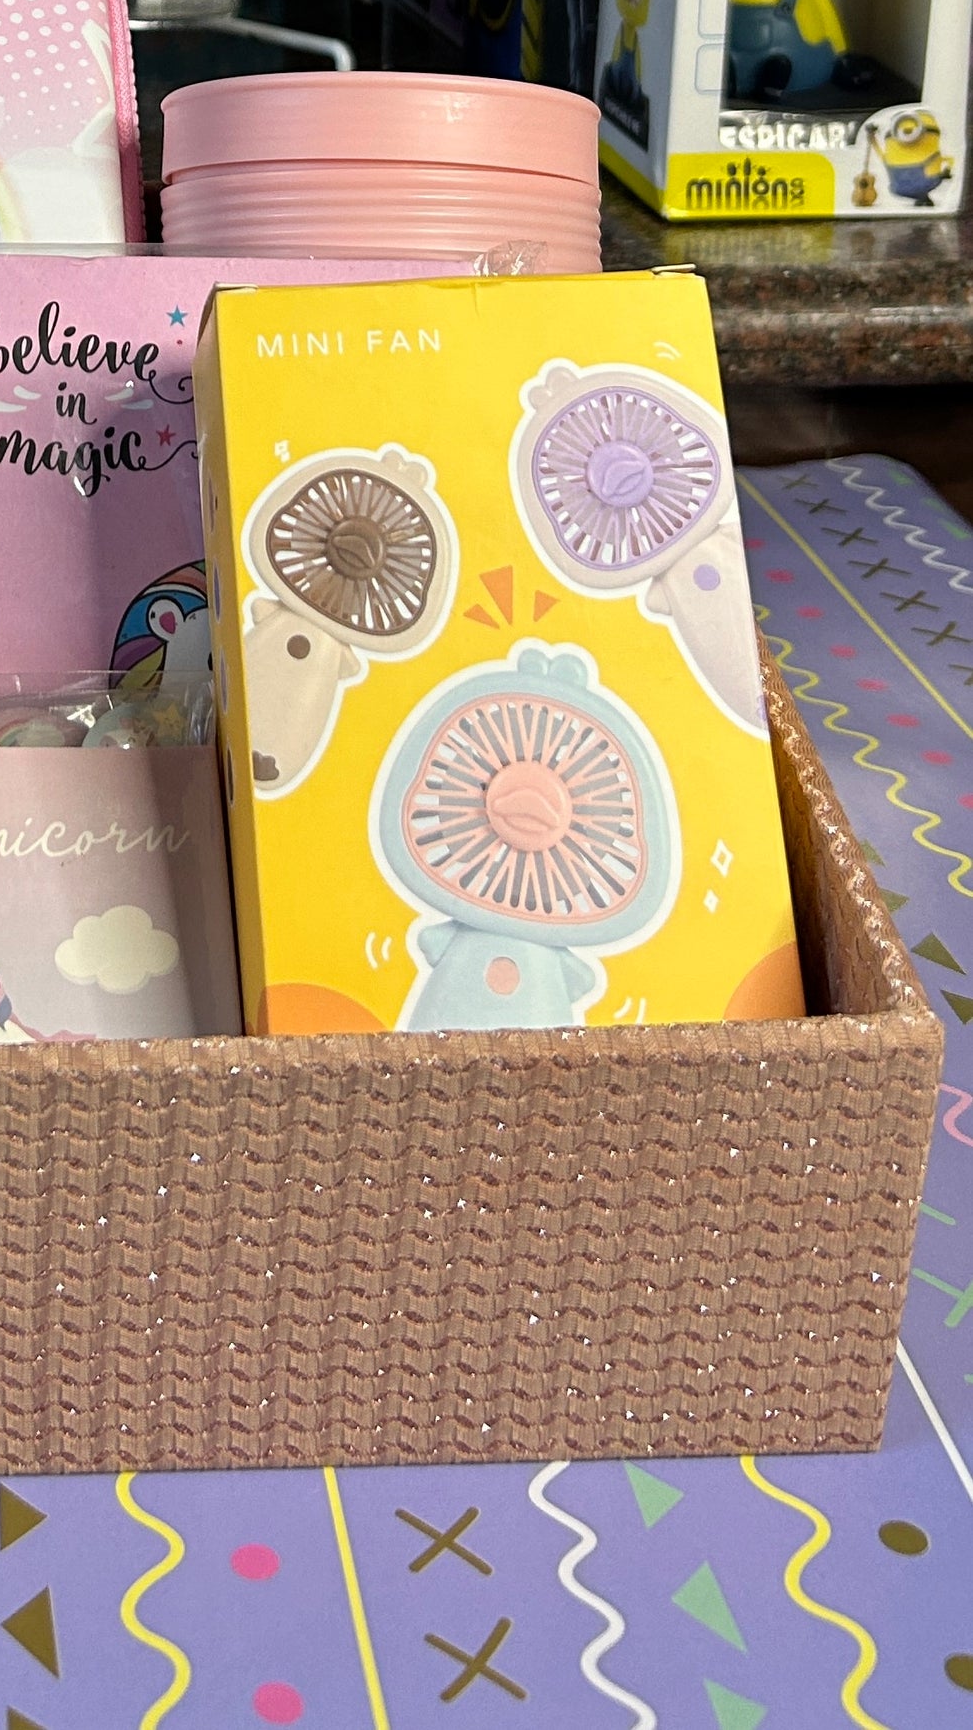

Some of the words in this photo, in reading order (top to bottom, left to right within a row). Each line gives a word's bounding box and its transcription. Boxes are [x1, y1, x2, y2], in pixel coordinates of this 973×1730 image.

[685, 160, 806, 208] minions
[256, 331, 344, 359] MINI
[366, 328, 442, 355] FAN
[55, 381, 98, 425] in
